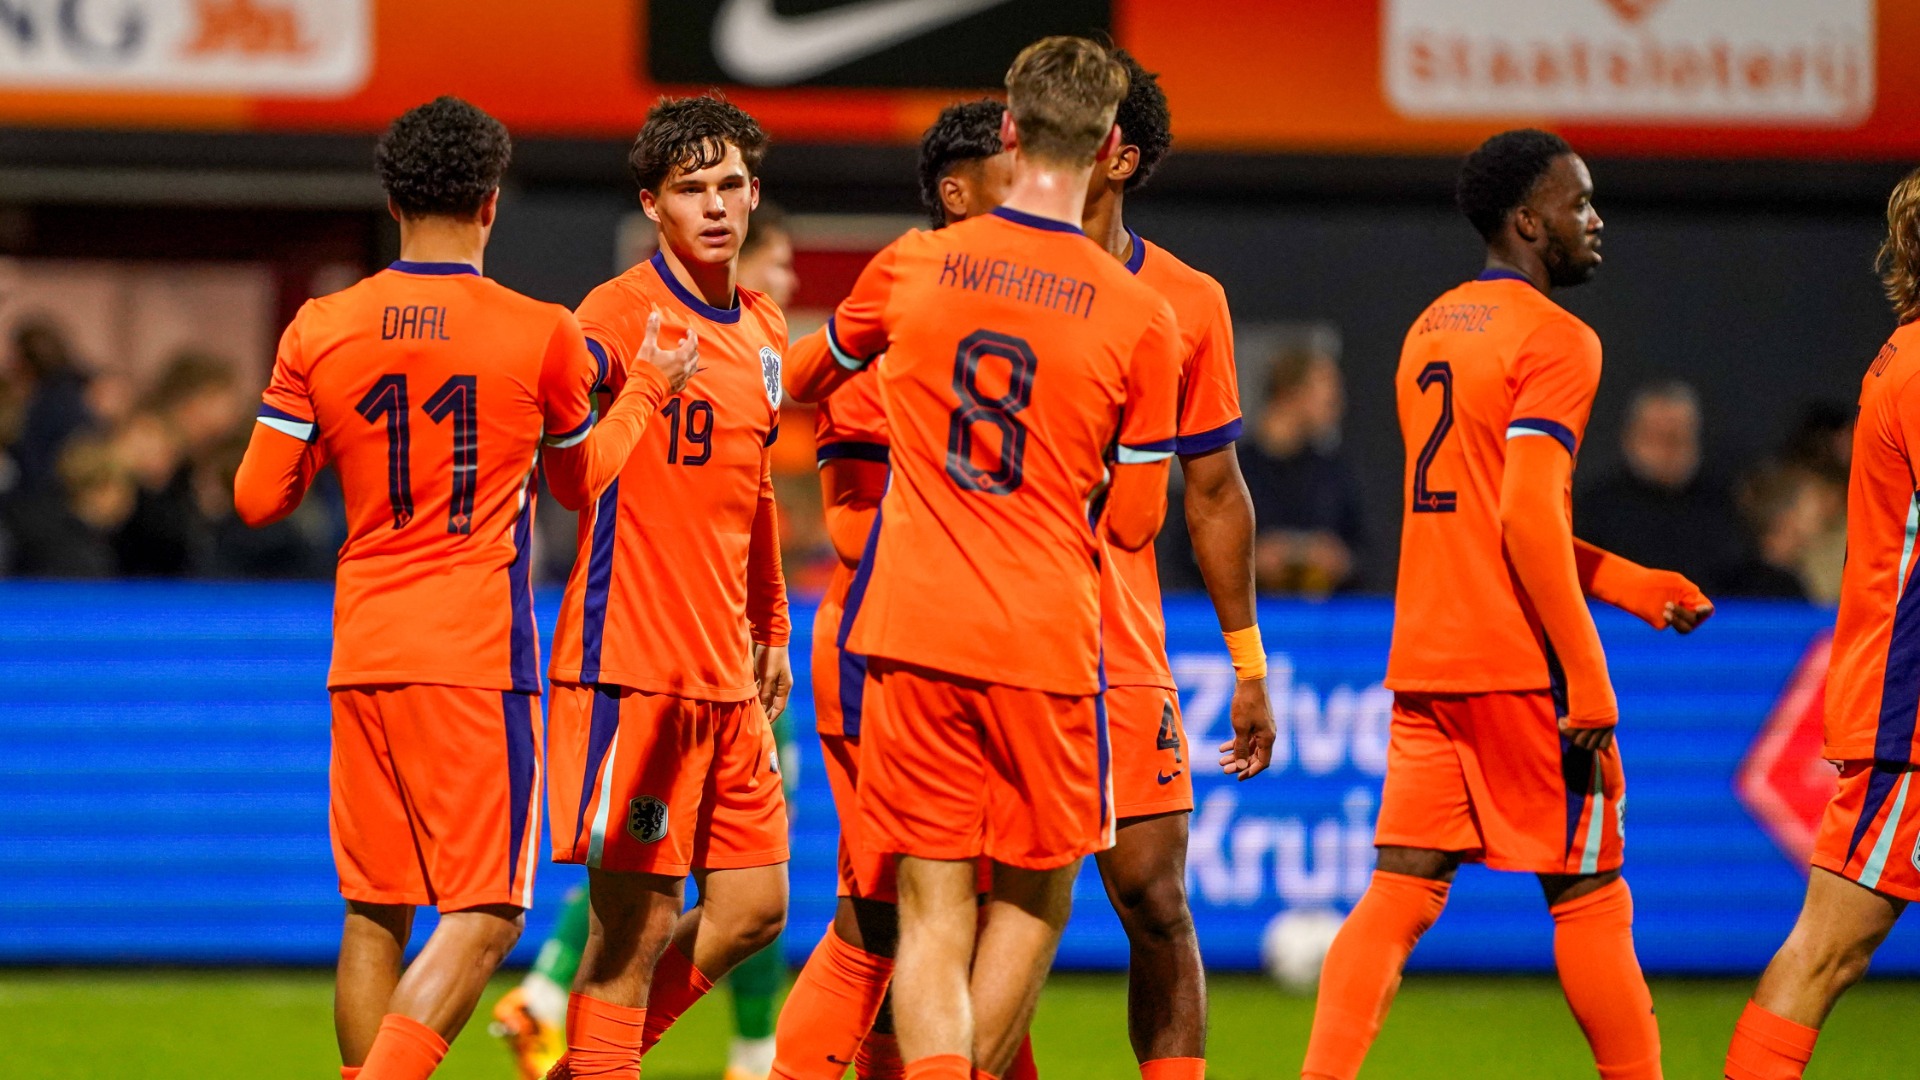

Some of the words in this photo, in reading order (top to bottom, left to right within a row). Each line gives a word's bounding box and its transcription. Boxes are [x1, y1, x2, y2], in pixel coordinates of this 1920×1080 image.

[939, 253, 1096, 319] KWAKMAN
[382, 305, 450, 340] DAAL
[660, 397, 714, 467] 19
[946, 328, 1038, 496] 8
[1412, 361, 1457, 513] 2
[354, 373, 478, 535] 11
[1156, 698, 1182, 763] 4
